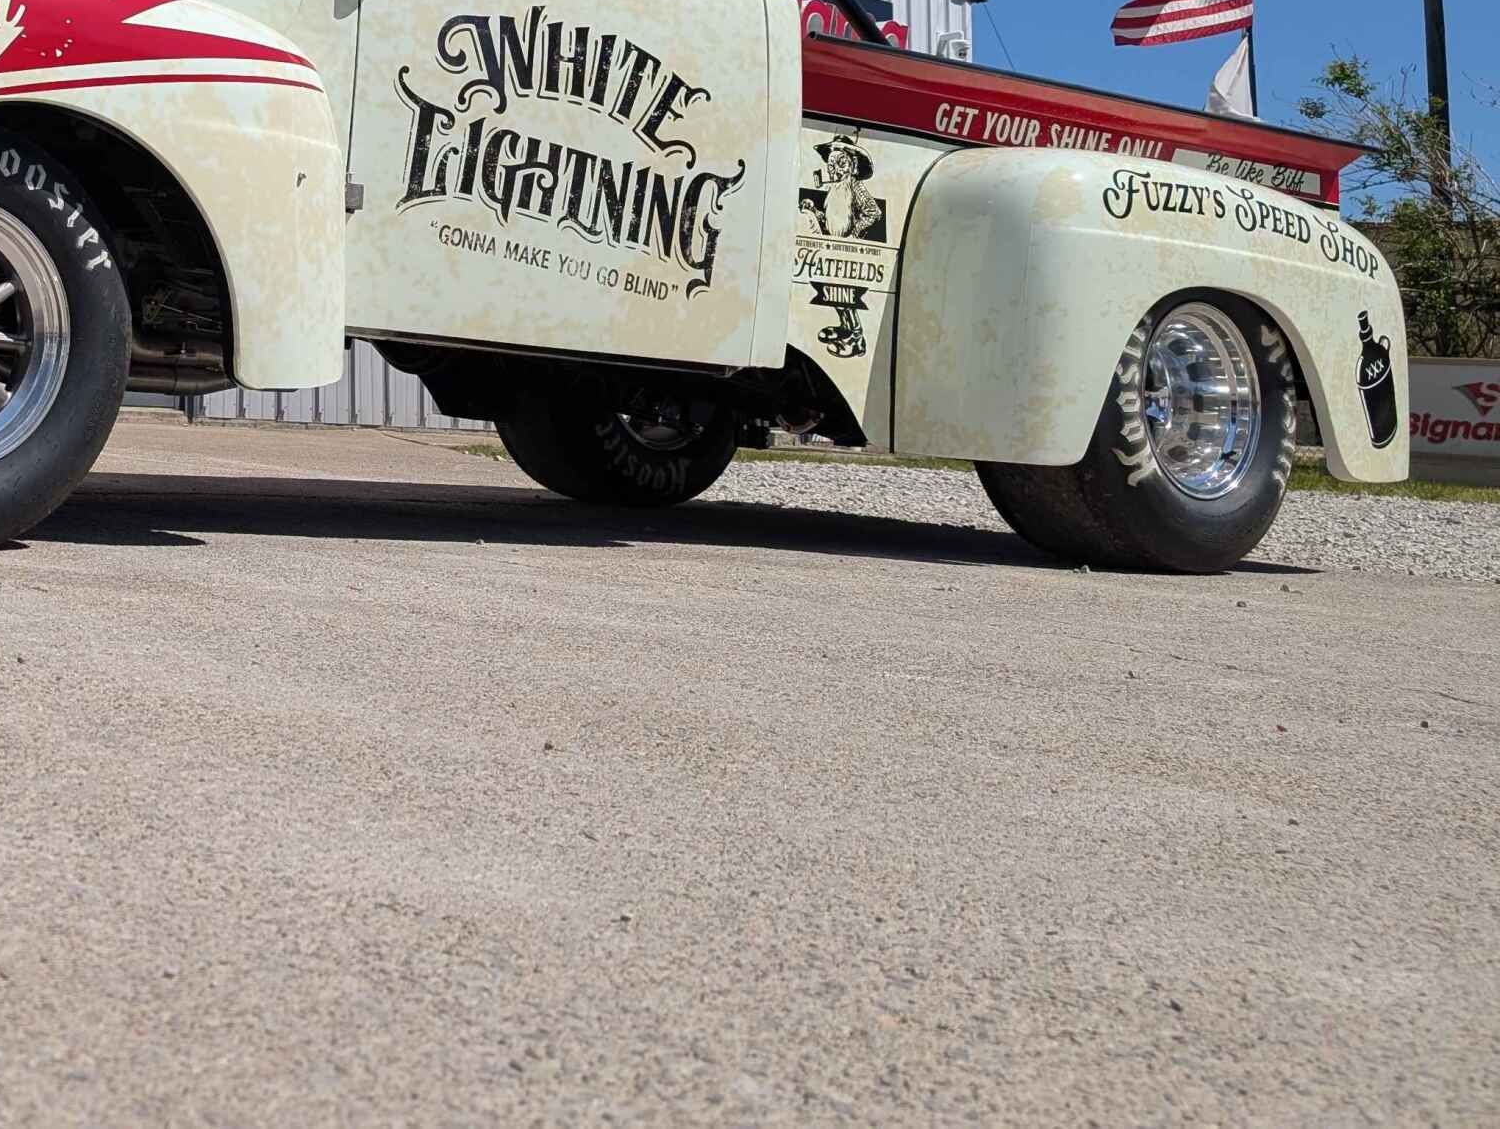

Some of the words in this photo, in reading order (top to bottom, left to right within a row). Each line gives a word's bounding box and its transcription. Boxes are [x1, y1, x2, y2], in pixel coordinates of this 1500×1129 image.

[435, 5, 712, 170] WHITE
[935, 102, 980, 135] GET
[983, 110, 1042, 148] YOUR
[1046, 122, 1112, 152] SHINE
[393, 65, 746, 300] LIGHTNING
[1205, 151, 1230, 176] Be
[1235, 160, 1265, 184] like
[1102, 169, 1226, 220] FUZZY'S
[1225, 184, 1311, 244] SPEED
[1313, 214, 1380, 280] SHOP
[504, 239, 552, 270] MAKE
[558, 252, 592, 280] YOU
[596, 266, 619, 288] GO
[794, 248, 885, 283] HATFIELDS
[823, 285, 857, 304] SHINE
[1364, 358, 1386, 381] XXX
